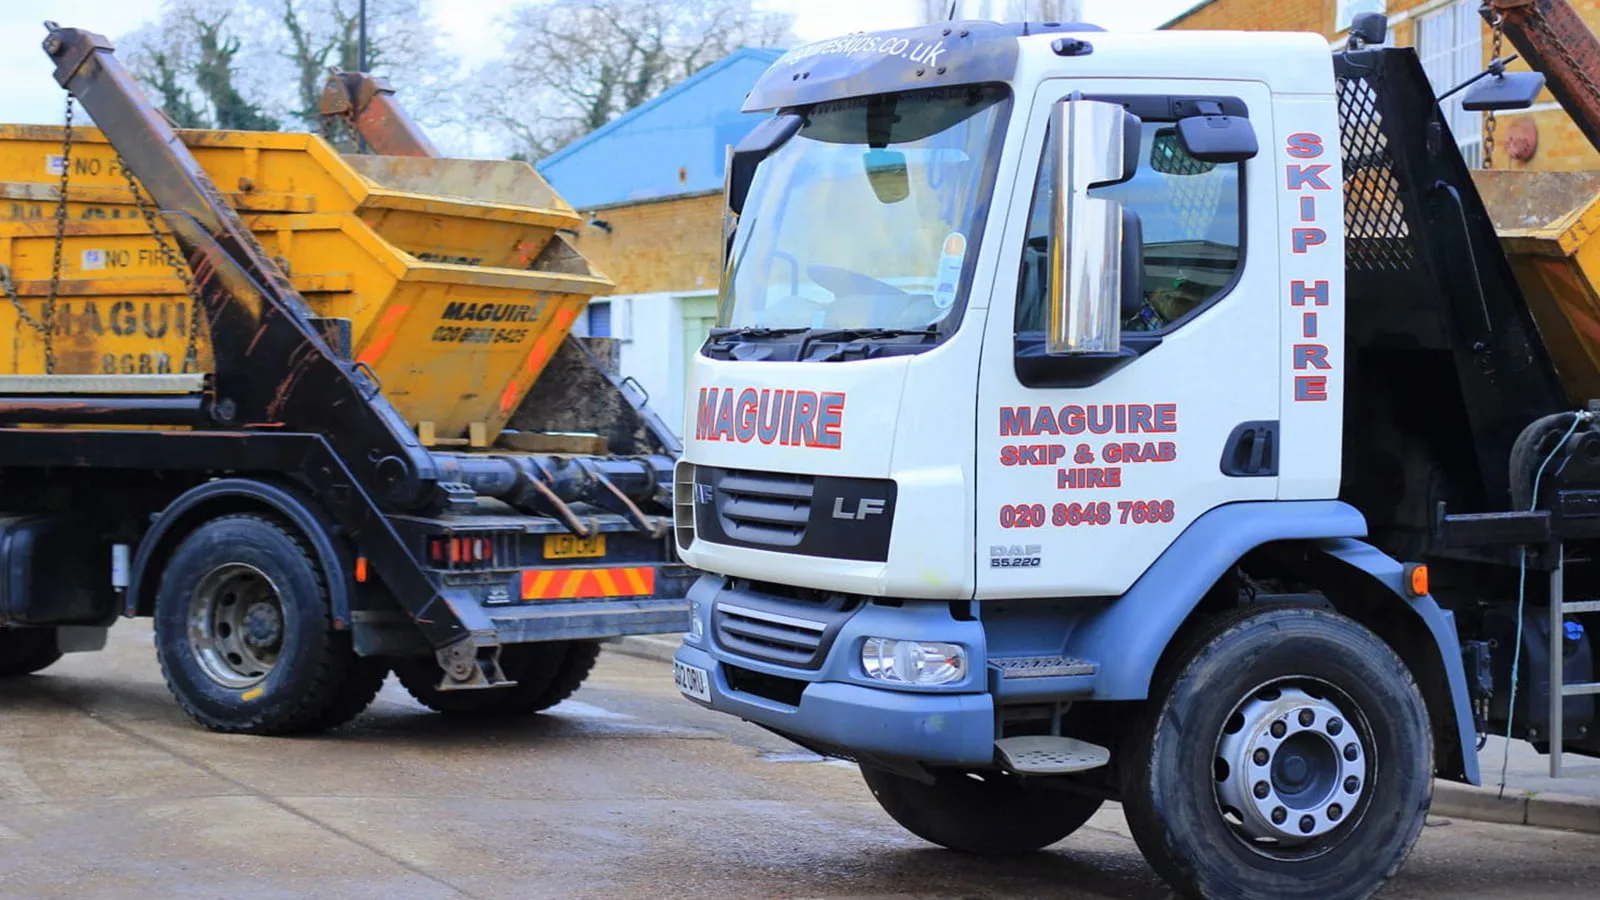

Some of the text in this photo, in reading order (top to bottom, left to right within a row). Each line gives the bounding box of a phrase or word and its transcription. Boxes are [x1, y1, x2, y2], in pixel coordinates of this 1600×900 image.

[75, 157, 101, 176] NO
[105, 249, 131, 267] NO
[1286, 133, 1333, 402] SKIP HIRE
[42, 302, 187, 338] MAGUI
[695, 387, 846, 450] MAGUIRE
[999, 403, 1177, 436] MAGUIRE
[1000, 441, 1177, 466] SKIP & GRAB
[1057, 467, 1121, 489] HIRE
[832, 497, 886, 520] LF
[999, 499, 1175, 529] 020 8648 7688
[990, 544, 1041, 556] DAF
[991, 557, 1041, 567] 55.220
